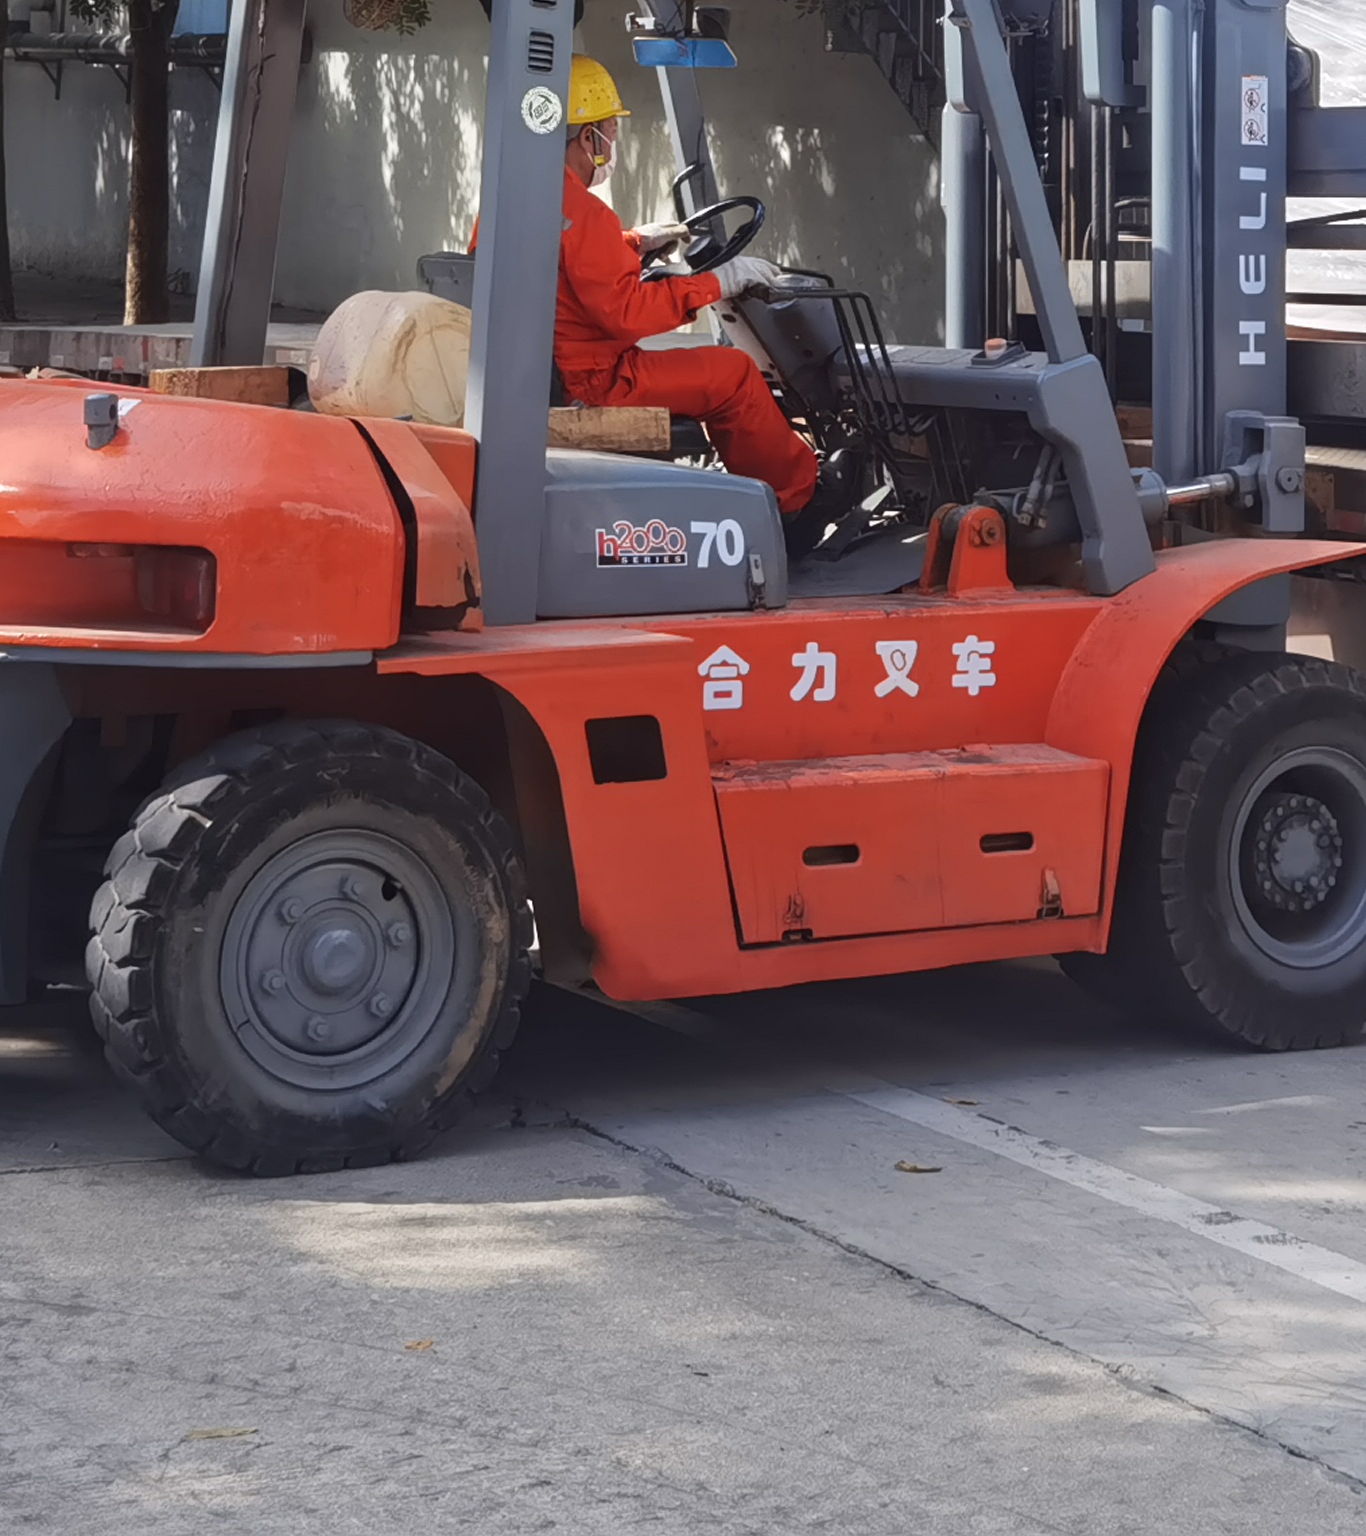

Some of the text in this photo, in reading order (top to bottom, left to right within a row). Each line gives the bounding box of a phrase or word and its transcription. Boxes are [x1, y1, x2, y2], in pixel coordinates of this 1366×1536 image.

[1238, 166, 1267, 366] HELI
[621, 555, 682, 565] SERIES
[690, 518, 745, 568] 70
[697, 634, 997, 711] 合力叉车
